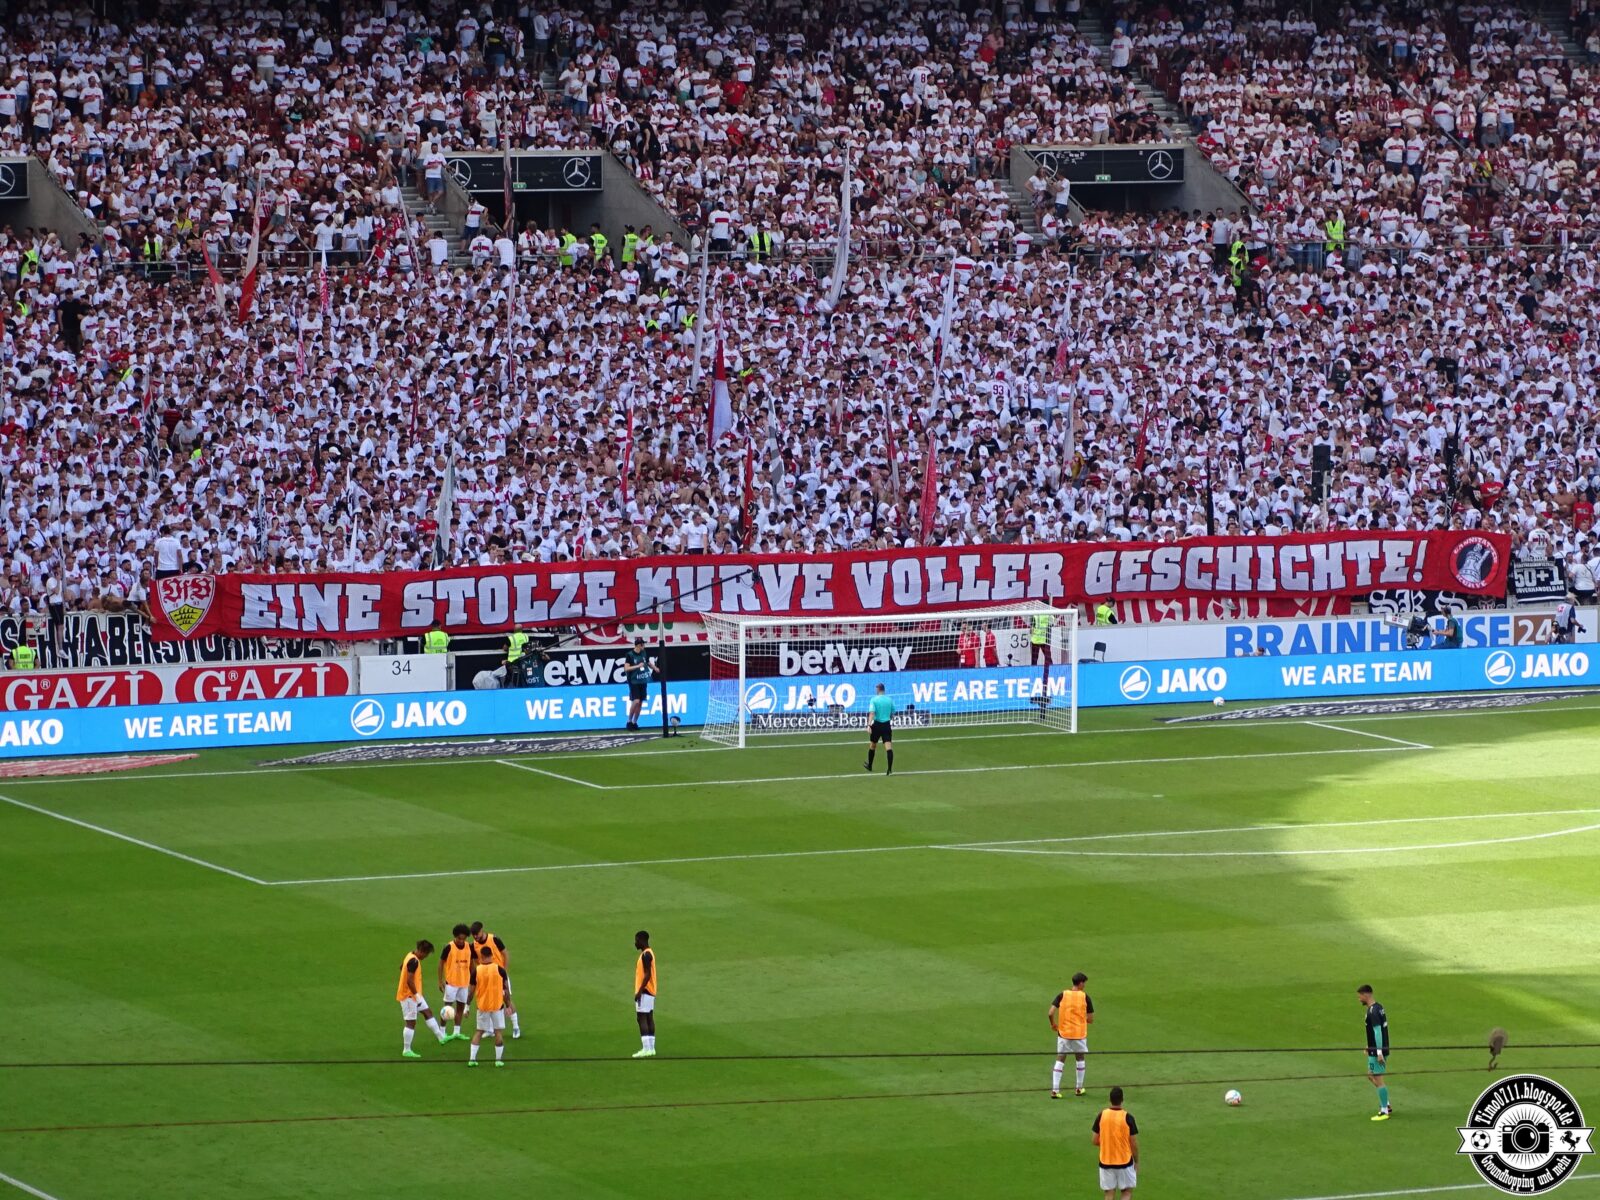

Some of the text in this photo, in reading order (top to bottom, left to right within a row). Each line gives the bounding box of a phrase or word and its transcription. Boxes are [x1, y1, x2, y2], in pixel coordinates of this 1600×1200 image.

[993, 384, 1004, 395] 93
[241, 582, 381, 632] EINE
[401, 570, 616, 628] STOLZE
[635, 562, 834, 614] KURVE
[850, 552, 1065, 609] VOLLER
[1085, 539, 1428, 596] GESCHICHTE!
[1514, 566, 1564, 588] 50+1
[1010, 633, 1029, 649] 35
[391, 659, 411, 676] 34
[779, 642, 912, 677] betway
[1521, 652, 1589, 679] JAKO
[1157, 666, 1227, 694] JAKO
[1282, 661, 1432, 686] WE ARE TEAM
[784, 683, 856, 711] JAKO
[912, 677, 1066, 703] WE ARE TEAM
[391, 700, 467, 729] JAKO
[526, 698, 563, 720] WE
[569, 696, 617, 718] ARE
[0, 718, 64, 747] AKO
[125, 711, 292, 739] WE ARE TEAM
